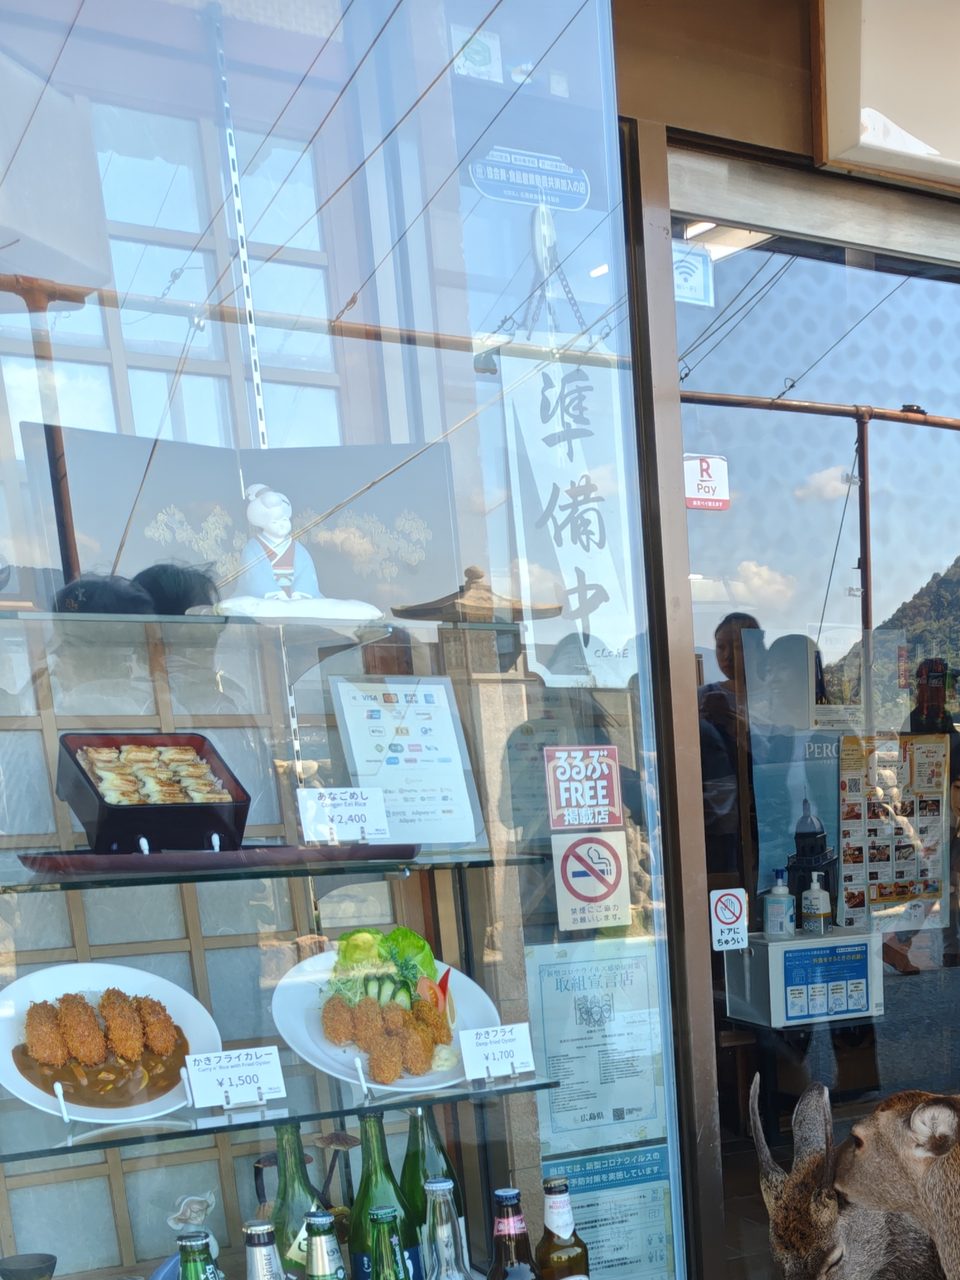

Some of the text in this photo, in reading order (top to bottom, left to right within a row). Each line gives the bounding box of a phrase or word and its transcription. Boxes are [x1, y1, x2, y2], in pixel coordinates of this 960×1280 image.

[696, 483, 717, 496] Pay
[535, 366, 611, 649] 準備中
[805, 742, 840, 758] PERO
[555, 750, 609, 781] るるぶ
[317, 791, 369, 801] あなごめし
[559, 780, 609, 807] FREE
[328, 813, 367, 825] ¥2,400
[563, 807, 610, 826] 掲載店
[720, 927, 740, 936] ドアに
[717, 937, 744, 947] ちゅうい
[555, 971, 635, 993] 取組宣言店
[475, 1027, 514, 1040] かきフライ
[193, 1051, 273, 1068] かきフライカレー
[483, 1049, 515, 1062] ¥1,700
[216, 1073, 259, 1088] ¥1,500
